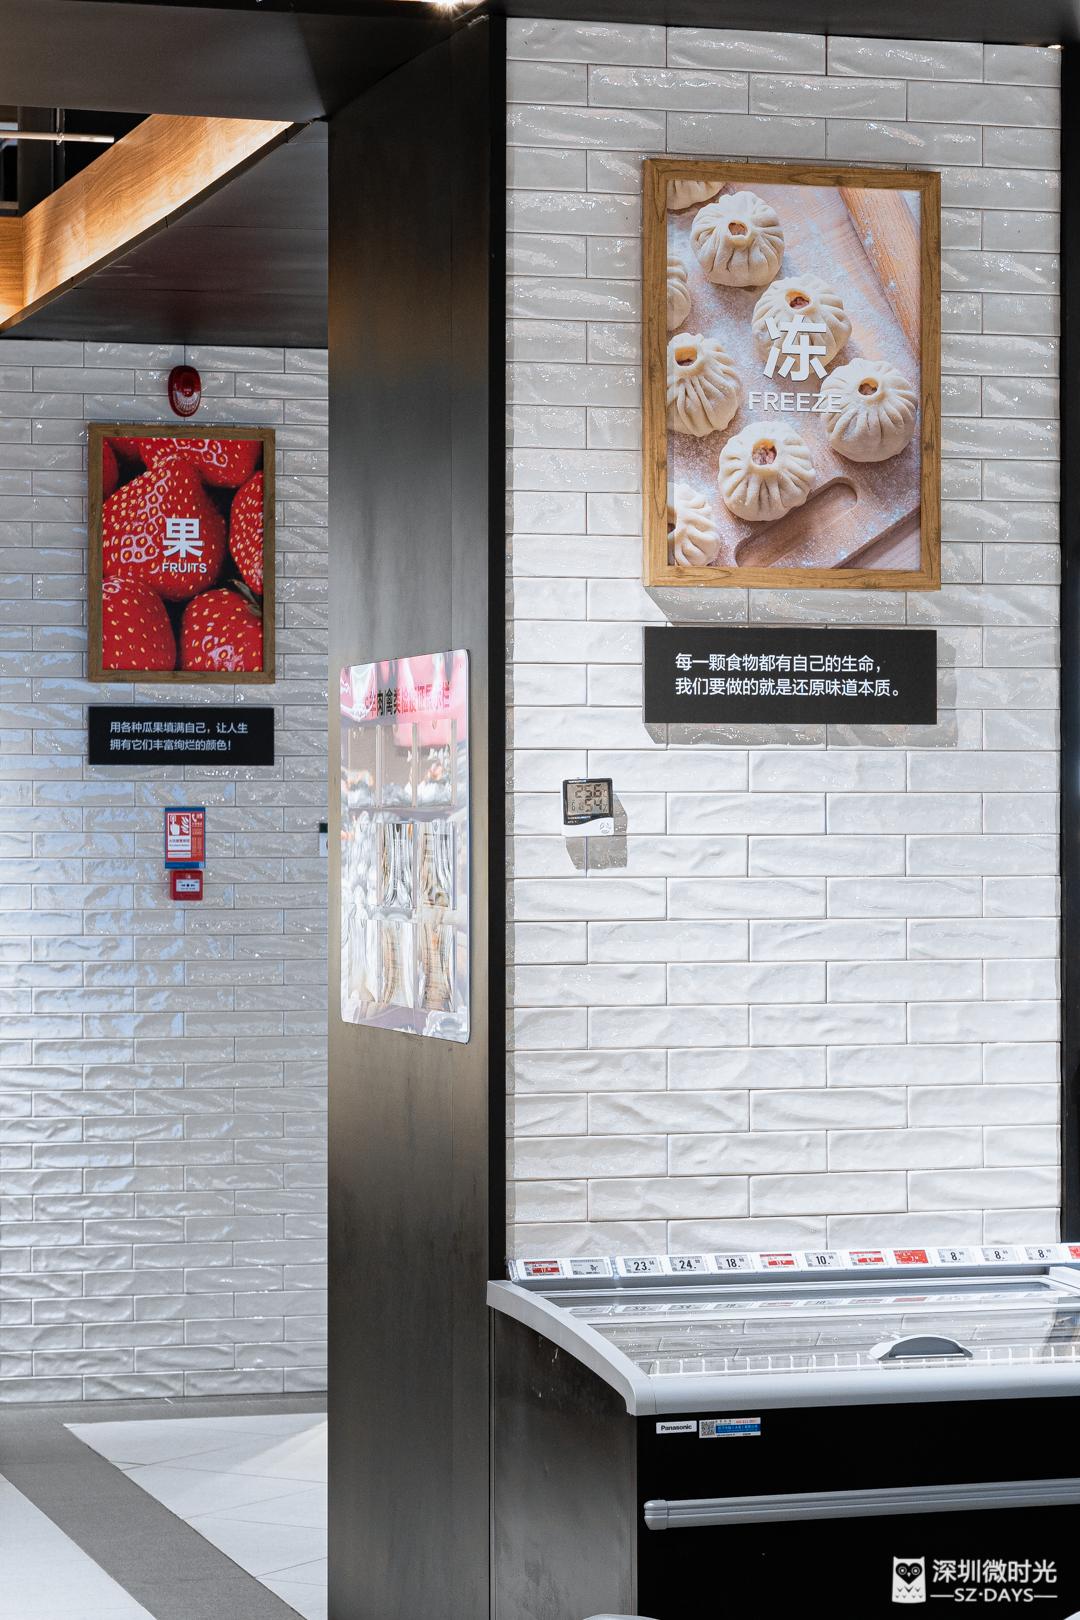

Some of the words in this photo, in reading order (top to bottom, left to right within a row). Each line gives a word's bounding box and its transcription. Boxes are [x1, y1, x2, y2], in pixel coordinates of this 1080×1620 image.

[763, 314, 828, 381] 冻
[748, 391, 842, 413] FREEZE
[162, 518, 204, 558] 果
[162, 562, 208, 573] FRUITS
[675, 653, 882, 673] 每一颗食物都有自己的生命，
[675, 677, 900, 697] 我们要做的就是还原味道本质。
